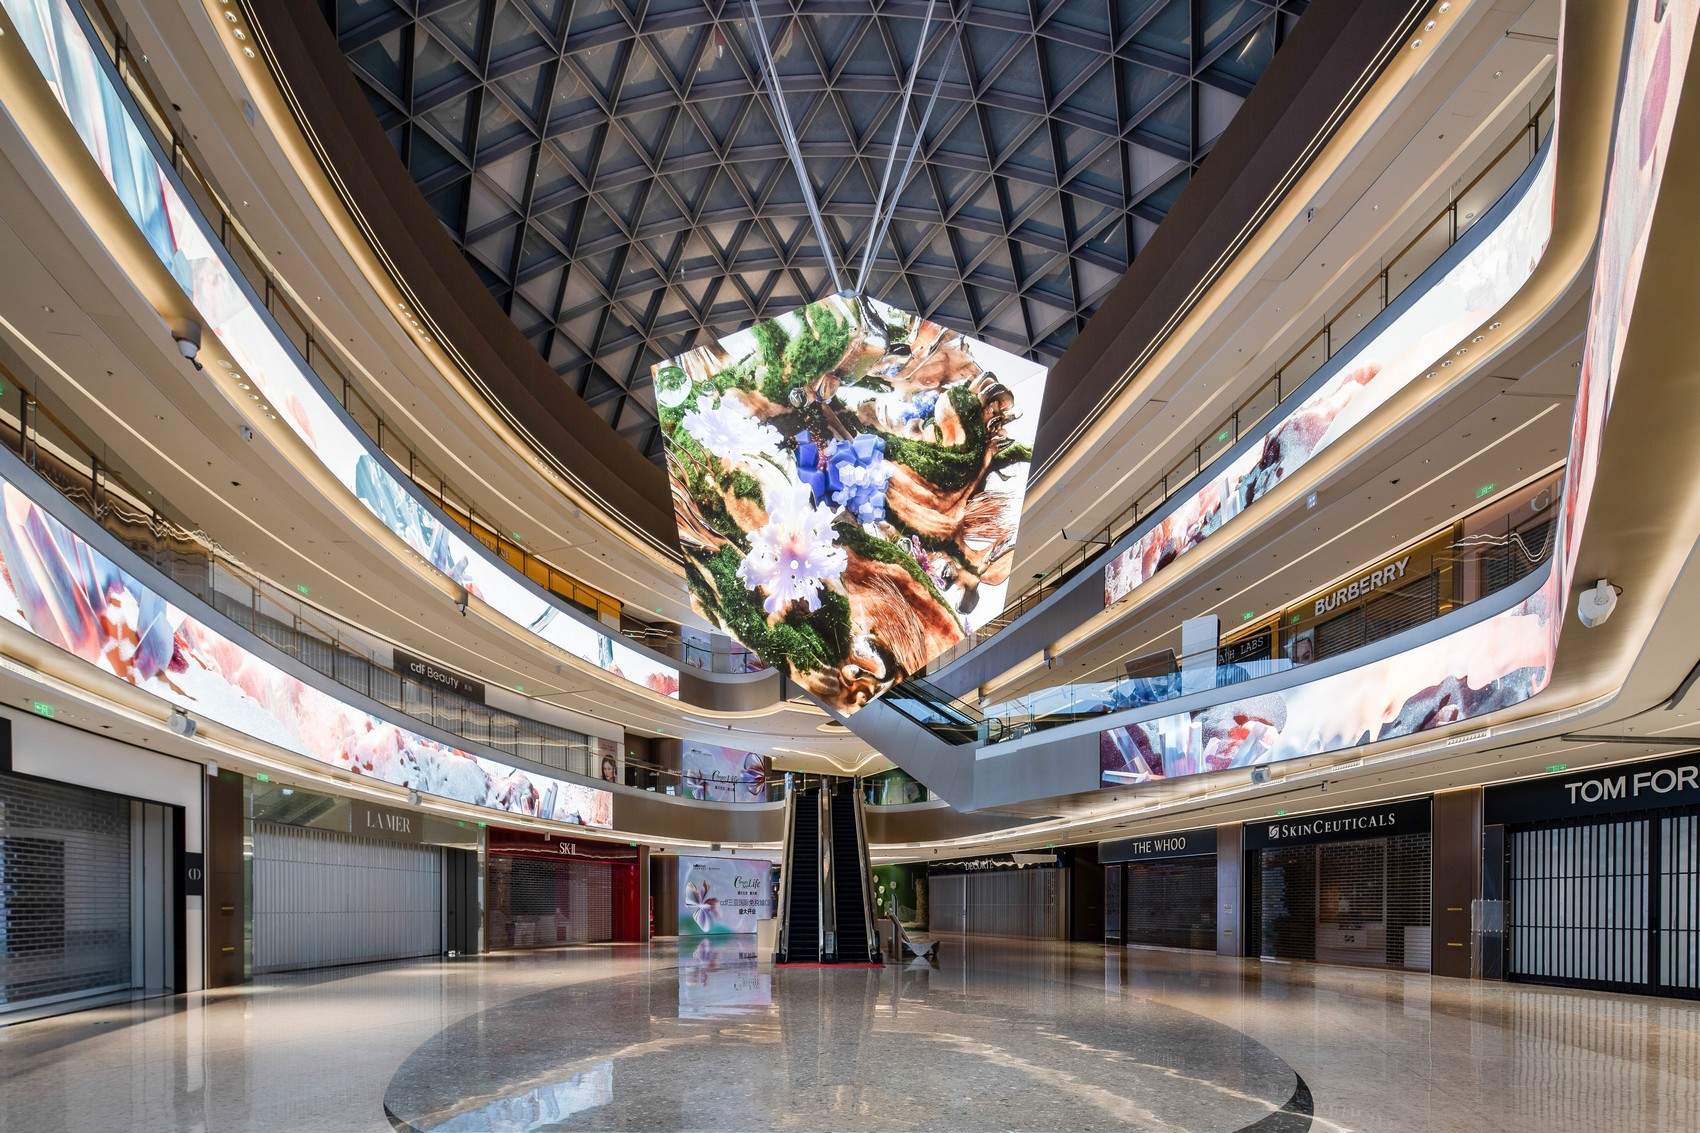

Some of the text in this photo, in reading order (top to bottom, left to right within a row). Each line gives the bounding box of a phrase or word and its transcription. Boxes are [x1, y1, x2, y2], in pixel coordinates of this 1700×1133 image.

[1314, 556, 1410, 616] BURBERRY
[1240, 637, 1264, 655] LABS
[410, 662, 426, 675] cdf
[427, 666, 459, 688] Beauty
[1564, 765, 1700, 804] TOM FOR
[386, 814, 411, 833] MER
[1132, 837, 1186, 855] THE WHOO
